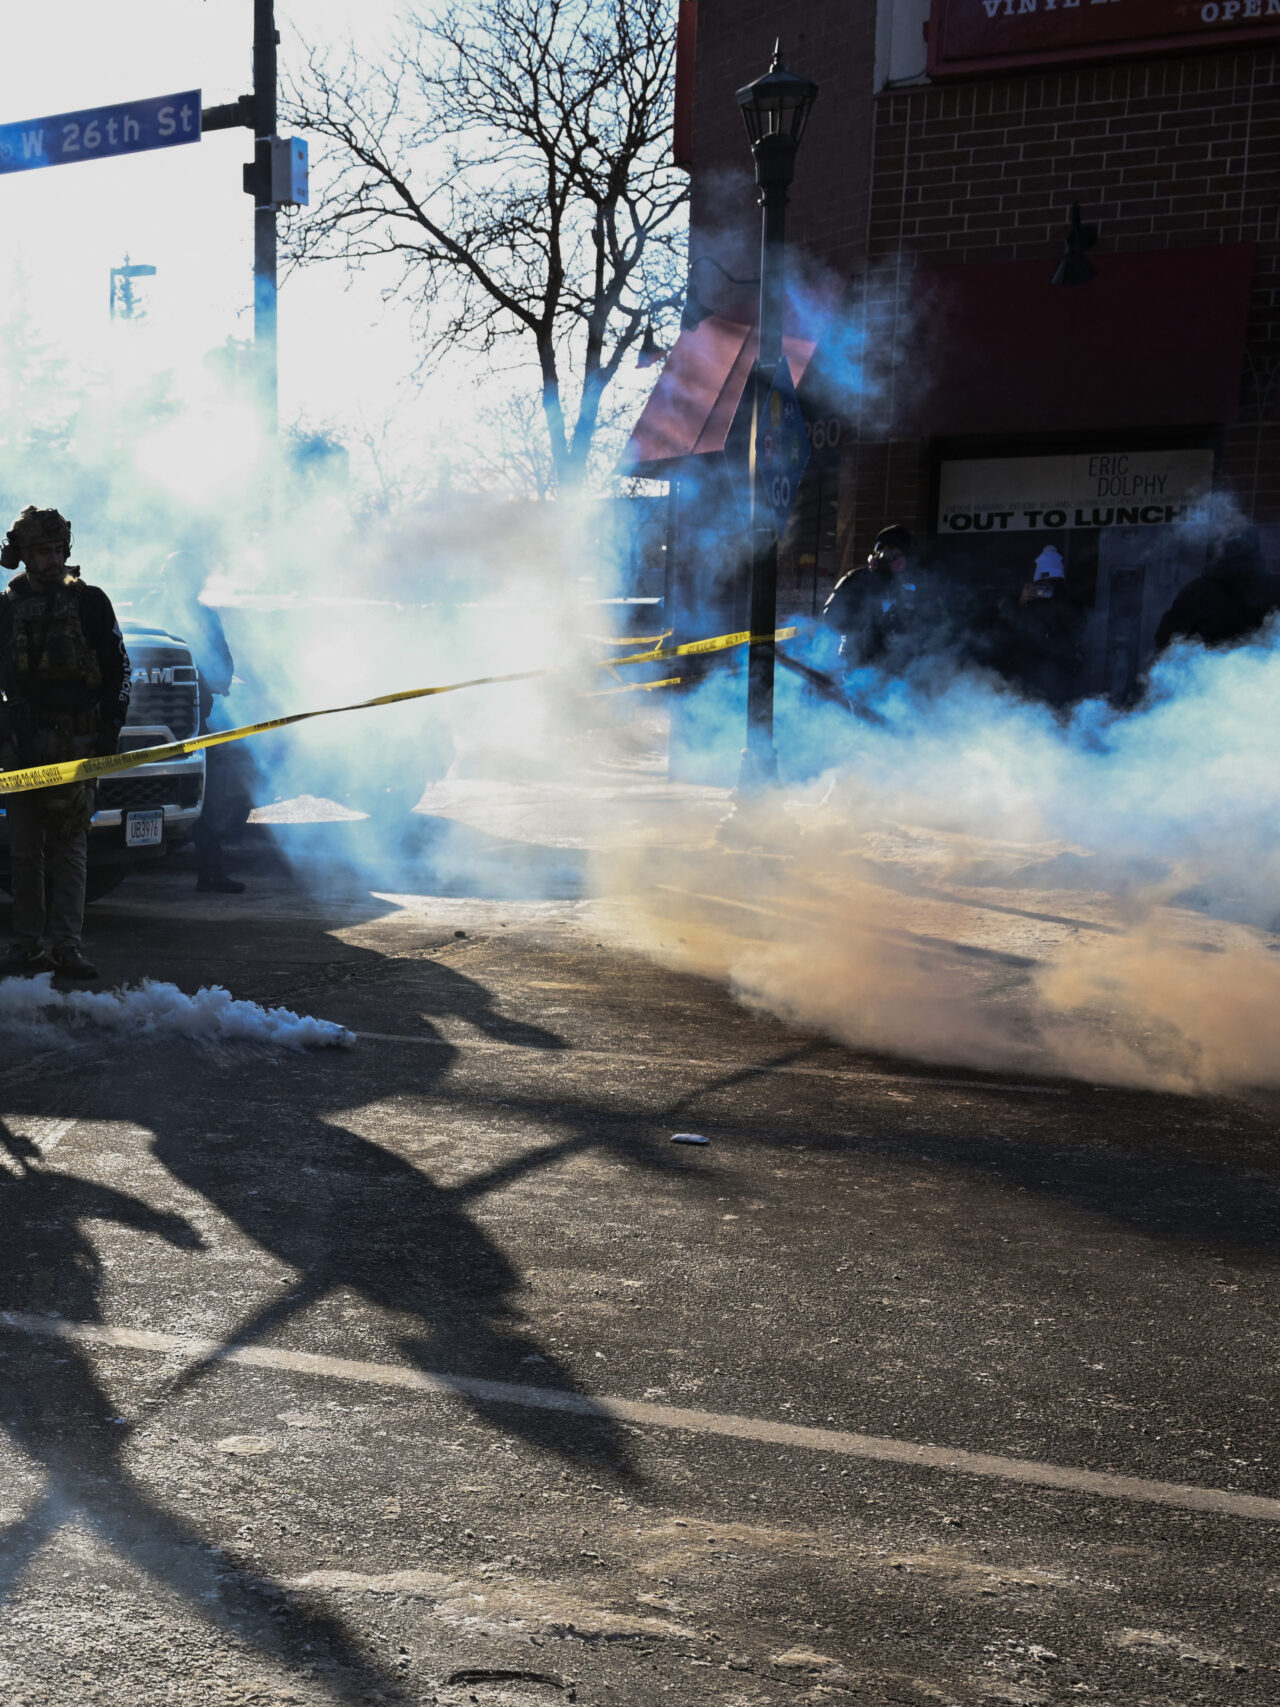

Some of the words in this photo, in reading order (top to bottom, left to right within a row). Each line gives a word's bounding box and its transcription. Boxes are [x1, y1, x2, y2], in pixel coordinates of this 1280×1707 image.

[21, 129, 44, 159] W
[61, 115, 140, 153] 26th
[157, 104, 193, 136] St
[1088, 455, 1129, 476] ERIC
[1098, 474, 1168, 497] DOLPHY
[1023, 509, 1067, 528] TO
[131, 667, 171, 685] AM
